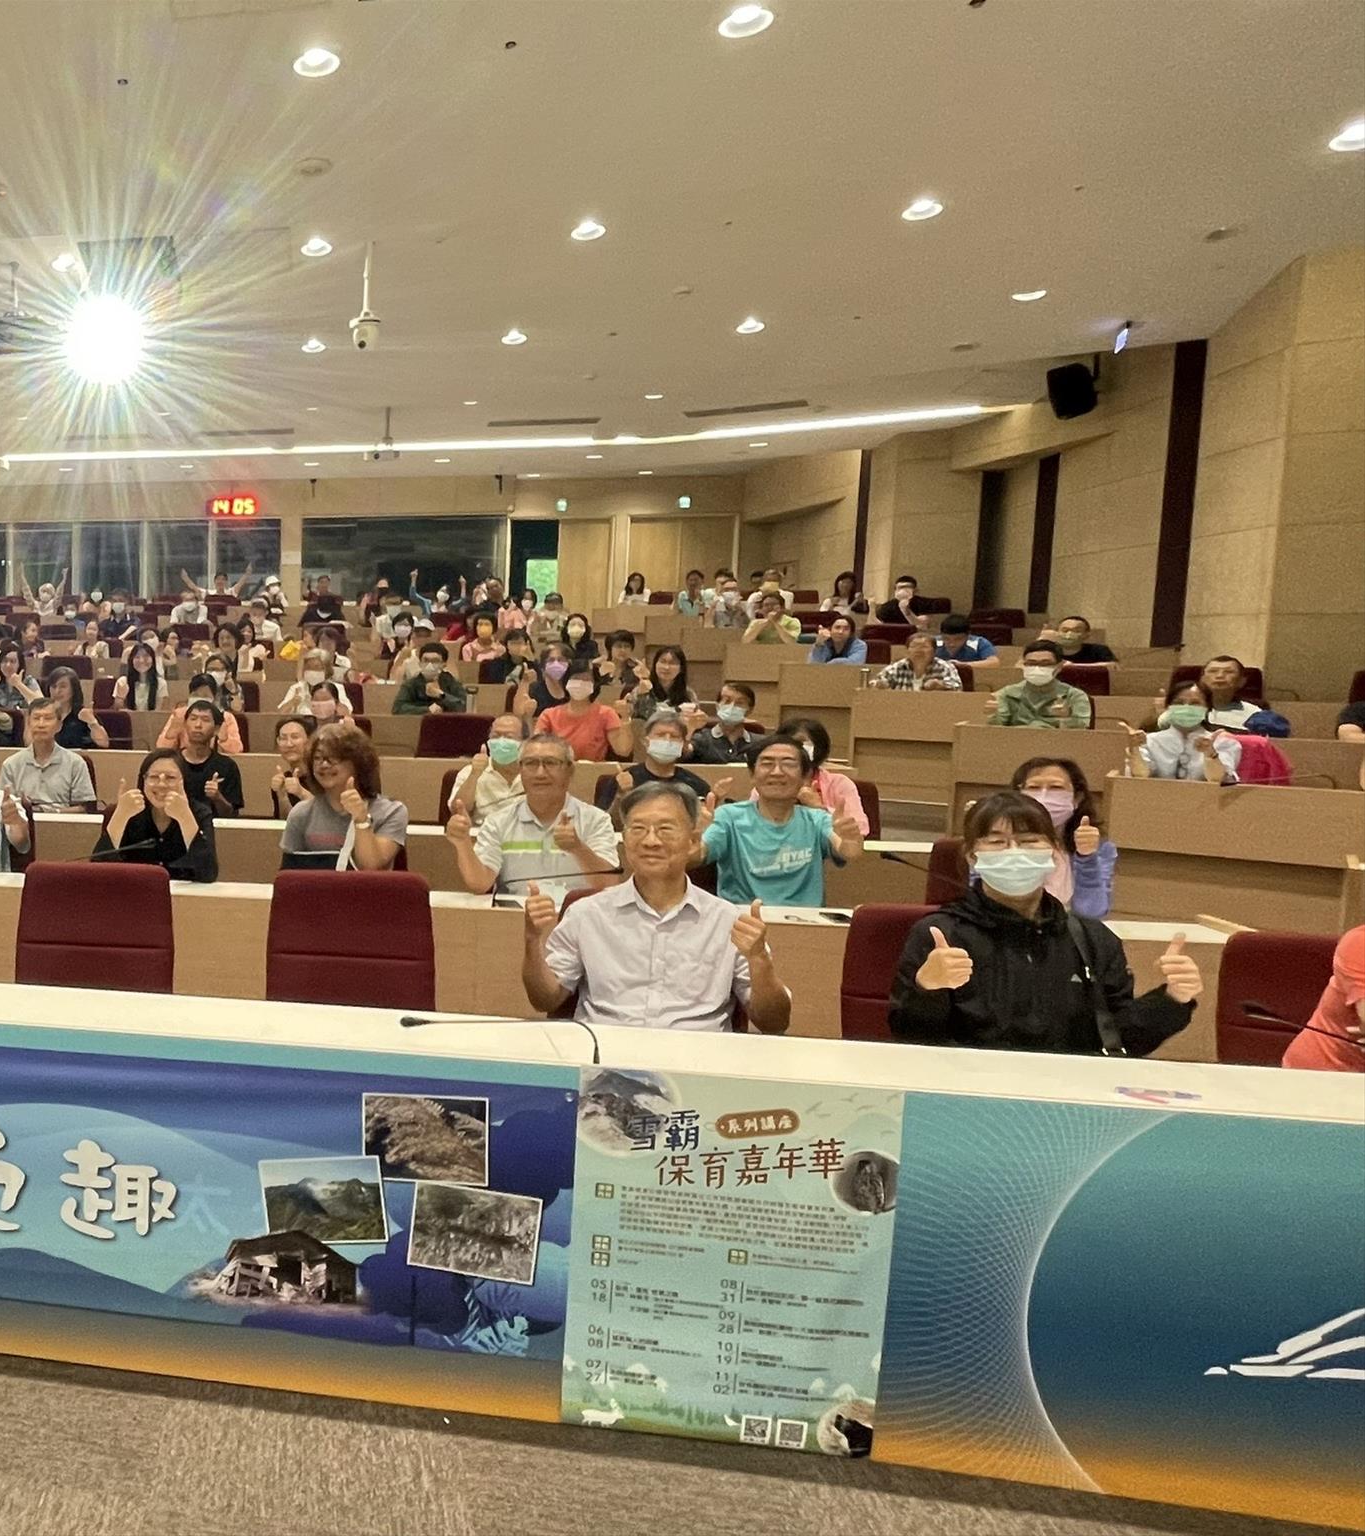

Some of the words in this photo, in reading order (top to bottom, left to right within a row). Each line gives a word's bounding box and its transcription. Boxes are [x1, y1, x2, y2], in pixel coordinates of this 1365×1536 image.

[627, 1109, 700, 1152] 雪霸
[654, 1138, 845, 1190] 保育嘉年華
[591, 1278, 607, 1290] 05
[720, 1278, 737, 1290] 08
[592, 1292, 607, 1302] 18
[721, 1292, 735, 1303] 31
[719, 1310, 735, 1320] 09
[588, 1324, 604, 1335] 06
[717, 1324, 735, 1334] 28
[587, 1338, 603, 1348] 08
[717, 1341, 733, 1352] 10
[585, 1359, 601, 1368] 07
[717, 1354, 732, 1364] 19
[585, 1372, 601, 1382] 27
[715, 1372, 729, 1382] 11
[713, 1384, 730, 1394] 02
